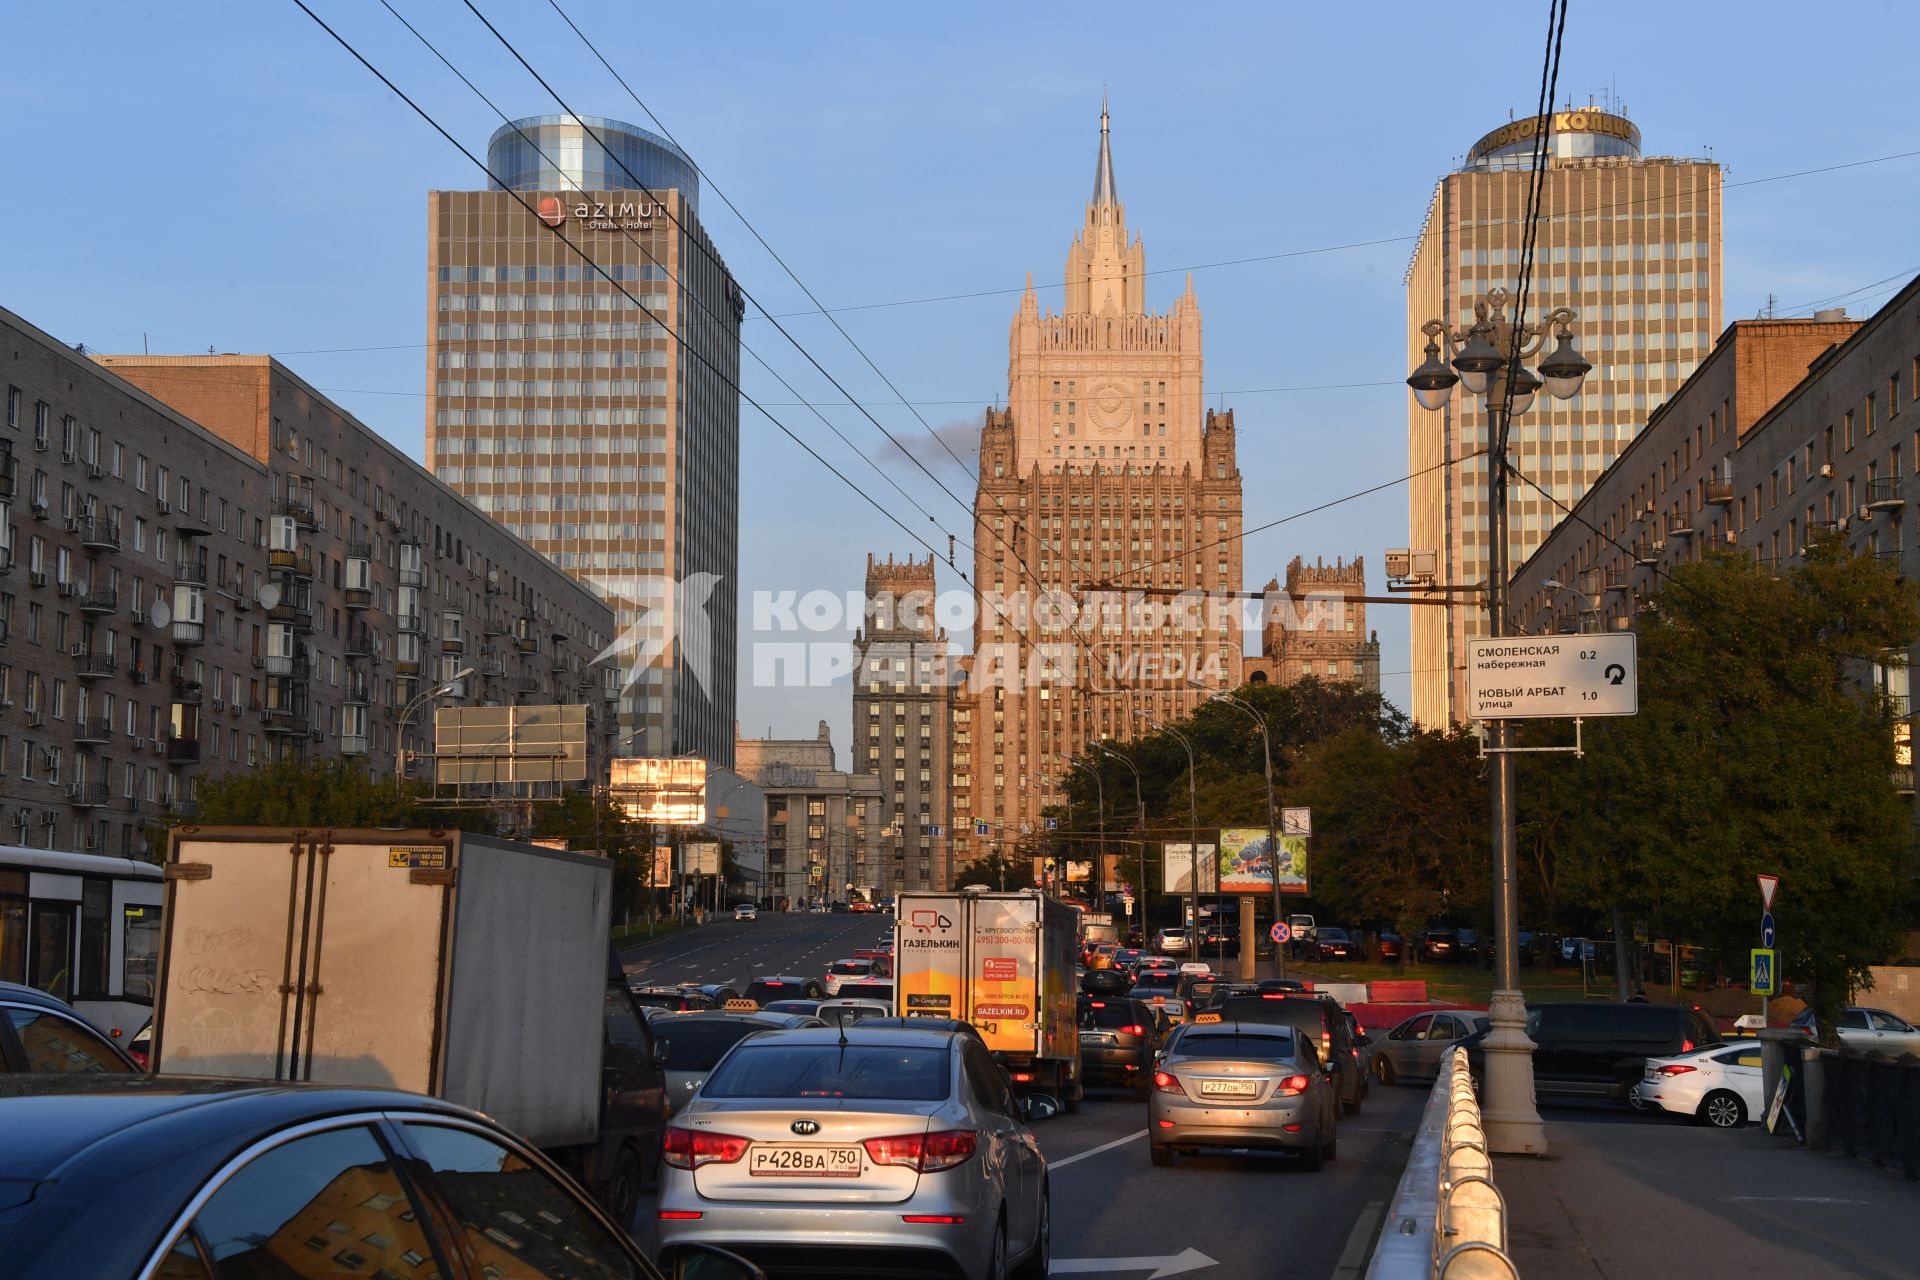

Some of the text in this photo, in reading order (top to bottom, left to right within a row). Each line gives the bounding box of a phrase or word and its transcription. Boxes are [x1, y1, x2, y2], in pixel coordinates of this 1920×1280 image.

[1555, 114, 1632, 139] КОЛЬЦО
[1477, 646, 1560, 658] СМОЛЕНСКАЯ
[1580, 651, 1597, 660] 0.2
[1477, 660, 1546, 671] набережная
[1478, 687, 1566, 698] НОВЫЙ АРБАТ
[1581, 691, 1598, 701] 1.0
[1478, 700, 1513, 711] улица
[903, 939, 960, 949] ГАЗЕЛЬКИН
[977, 1008, 1026, 1016] GAZELKIN.RU
[794, 1122, 816, 1133] KIA
[829, 1150, 856, 1164] 750
